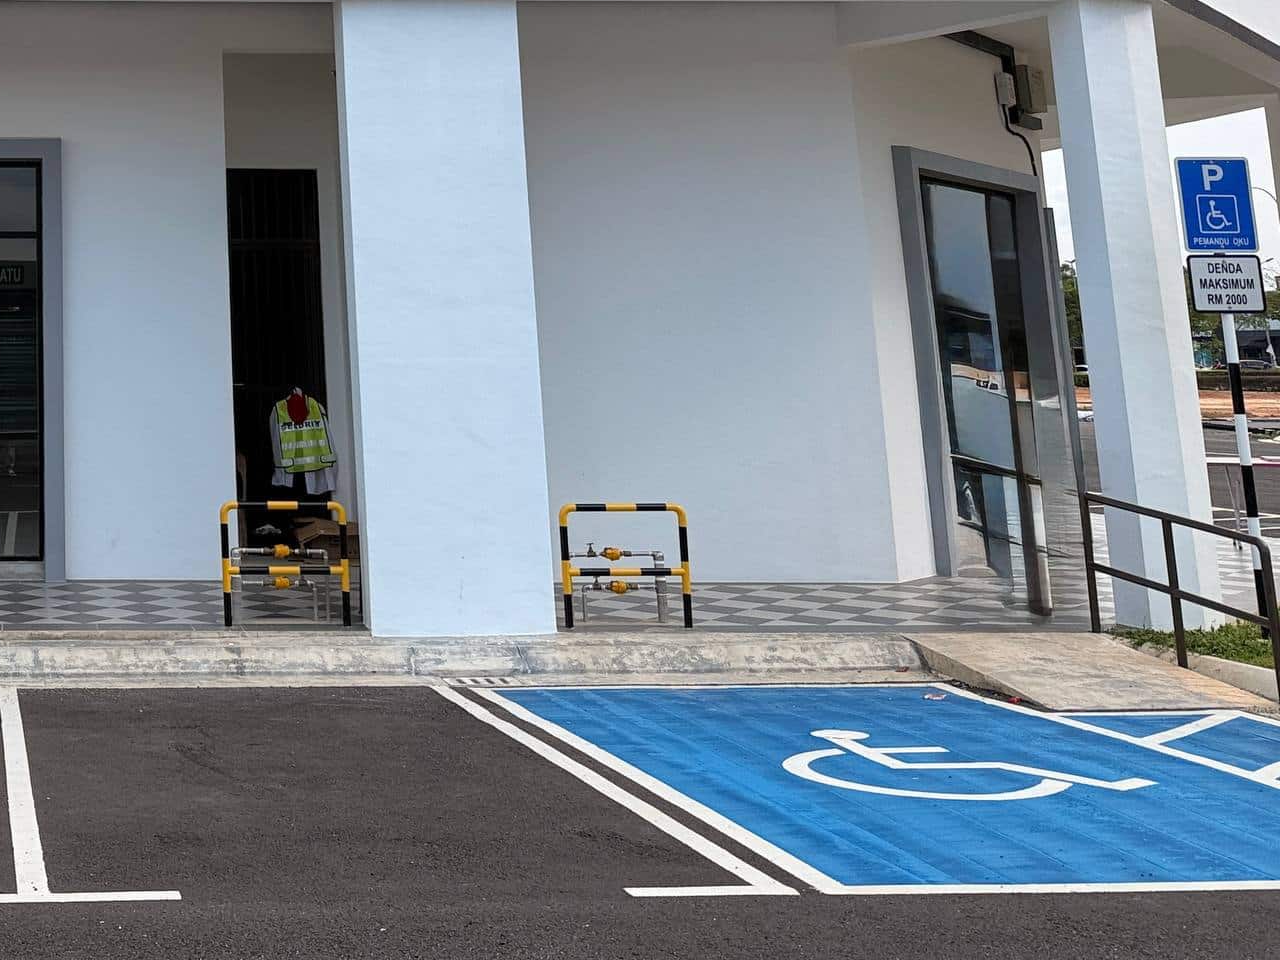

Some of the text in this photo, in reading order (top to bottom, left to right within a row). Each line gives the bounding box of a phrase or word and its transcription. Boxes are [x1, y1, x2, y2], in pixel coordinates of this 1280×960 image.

[1201, 164, 1224, 191] P
[1193, 236, 1250, 246] PEMANDU OKU
[1207, 262, 1243, 274] DENDA
[1199, 278, 1255, 290] MAKSIMUM
[1207, 293, 1248, 305] RM 2000
